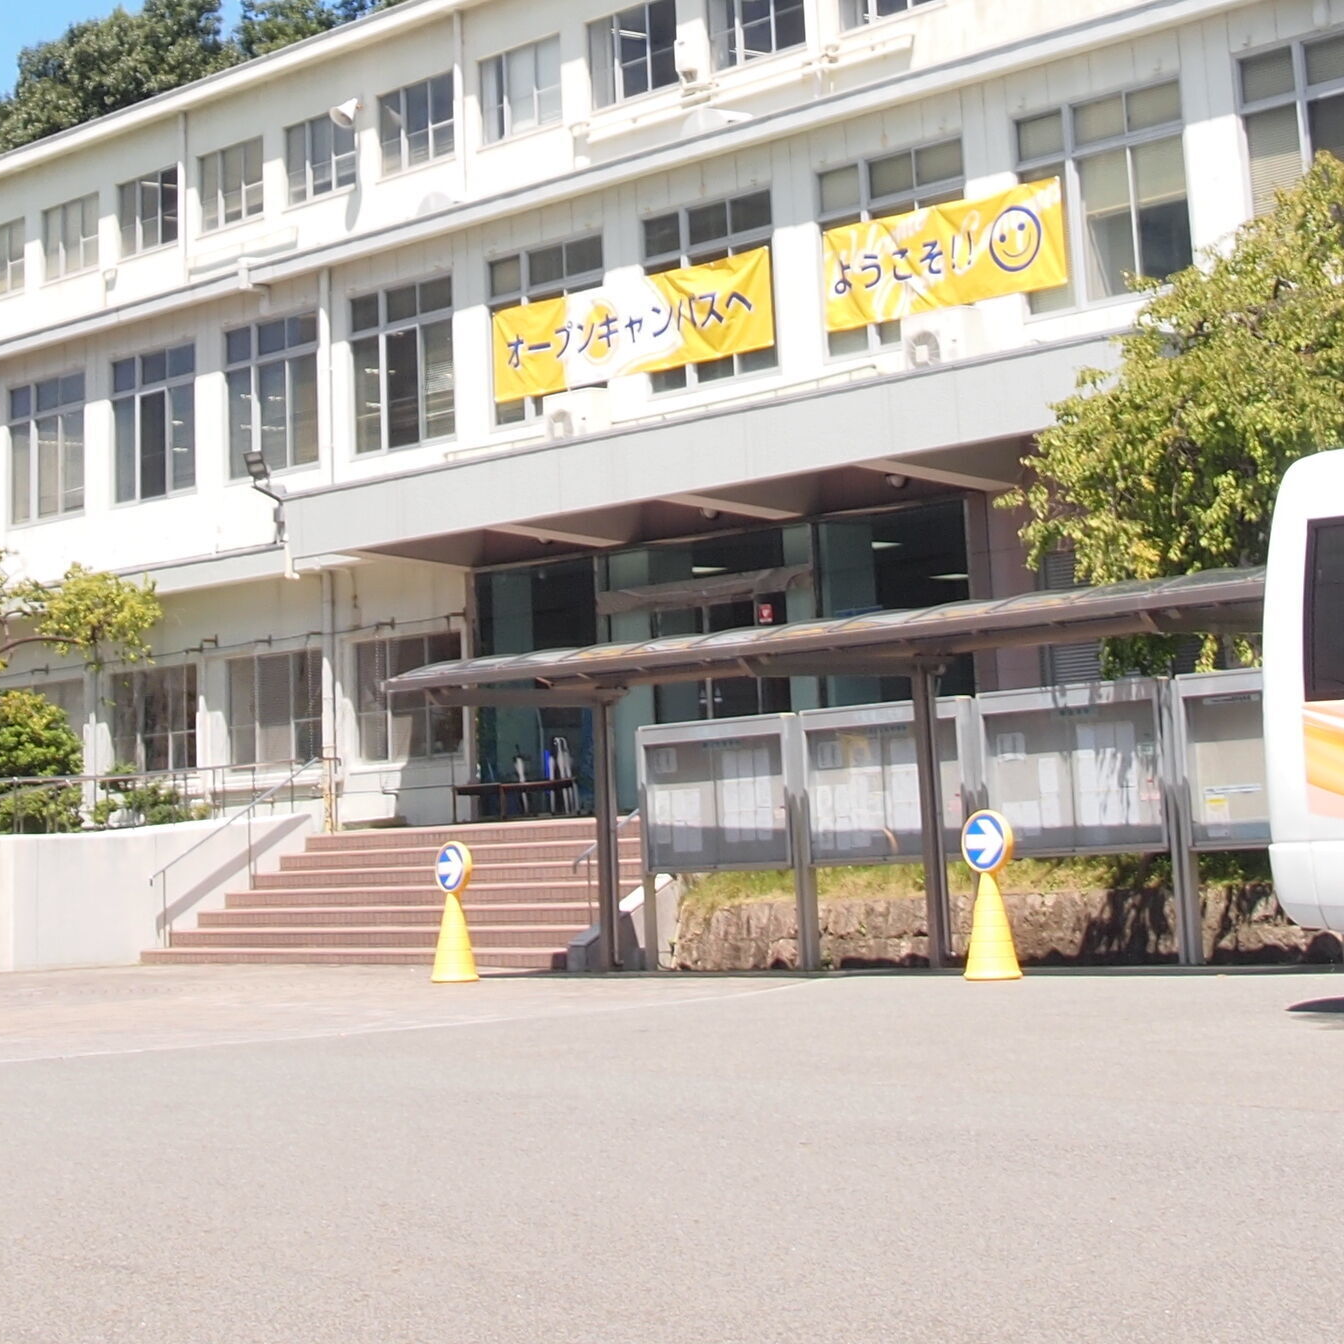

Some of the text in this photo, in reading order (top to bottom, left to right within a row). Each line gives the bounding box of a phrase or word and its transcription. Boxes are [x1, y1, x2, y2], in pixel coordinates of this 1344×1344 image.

[507, 291, 753, 368] オープンキャンパスへ
